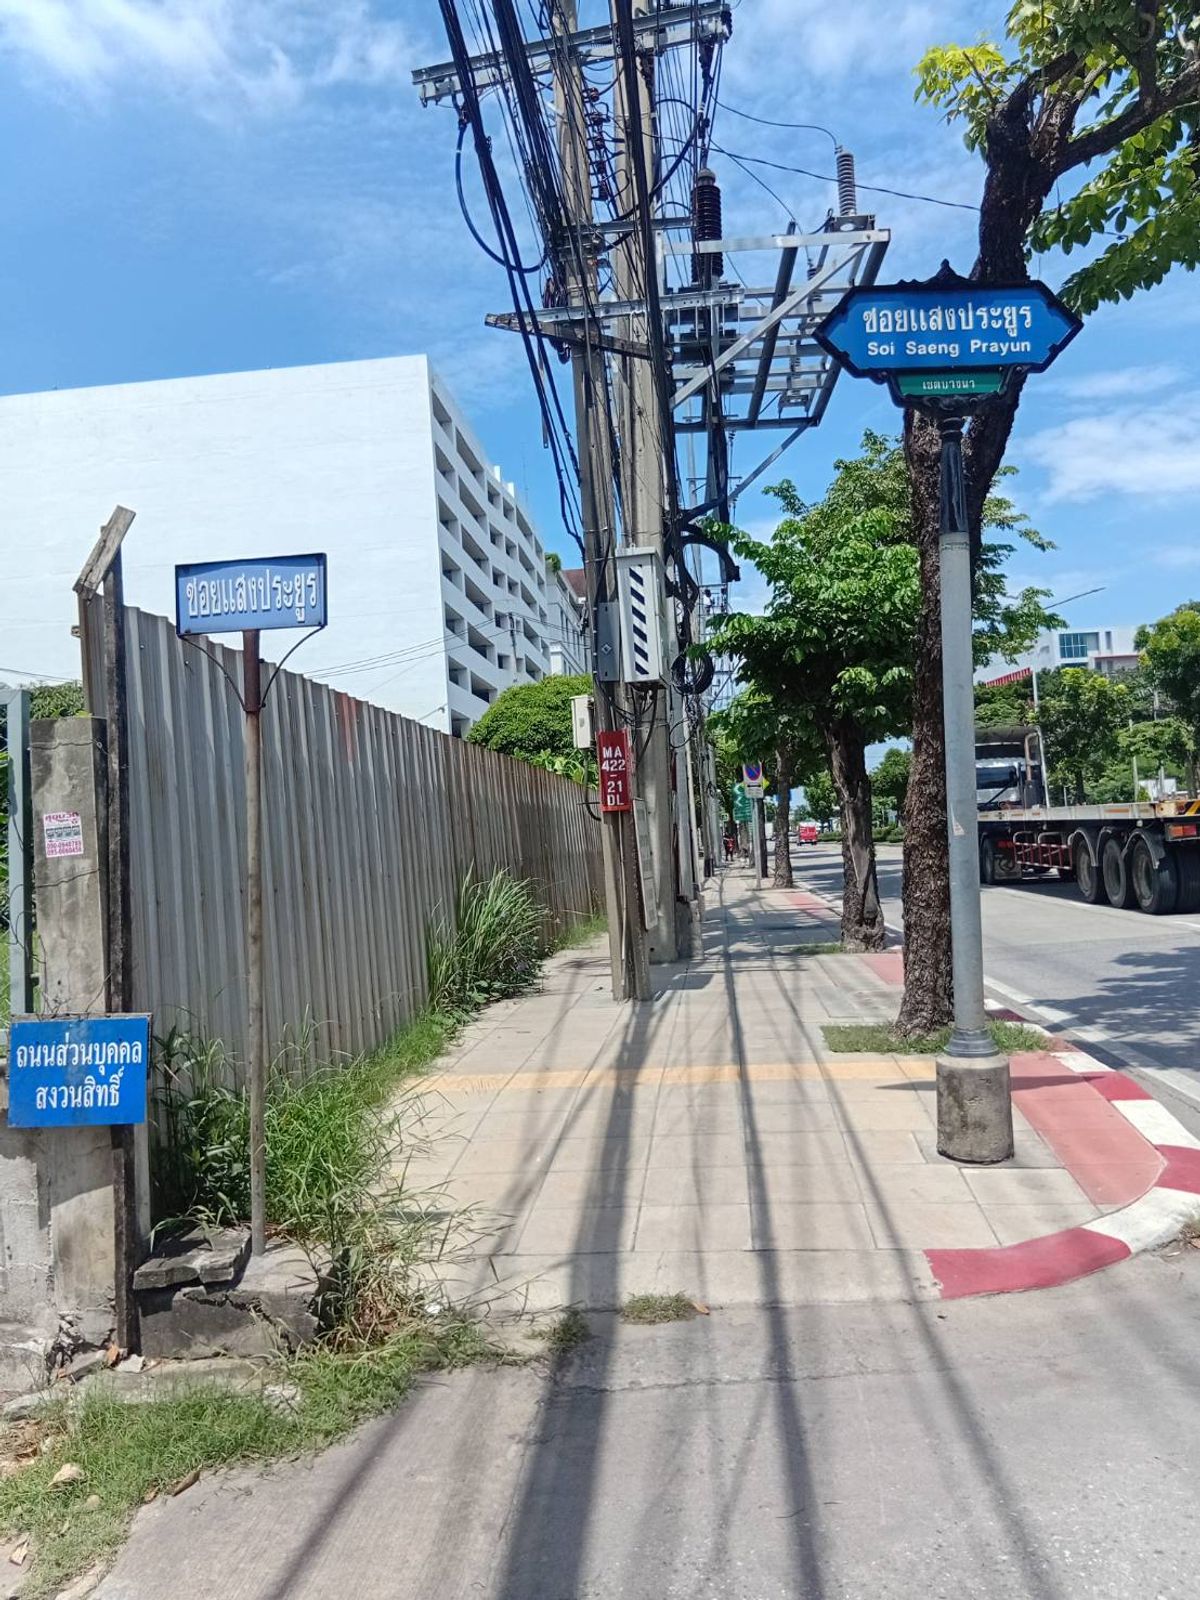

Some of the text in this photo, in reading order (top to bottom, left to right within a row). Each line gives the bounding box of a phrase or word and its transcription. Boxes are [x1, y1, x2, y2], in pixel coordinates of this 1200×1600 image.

[862, 303, 1032, 337] ซอยแสงประยูร
[867, 338, 1031, 357] Soi Saeng Prayun
[186, 568, 317, 622] ซอยแสงประยูร
[602, 746, 622, 758] MA
[601, 760, 626, 771] 422
[607, 780, 623, 793] 21
[16, 1033, 142, 1076] ถนนส่วนบุคคล
[35, 1066, 124, 1110] สงวนสิทธิ์
